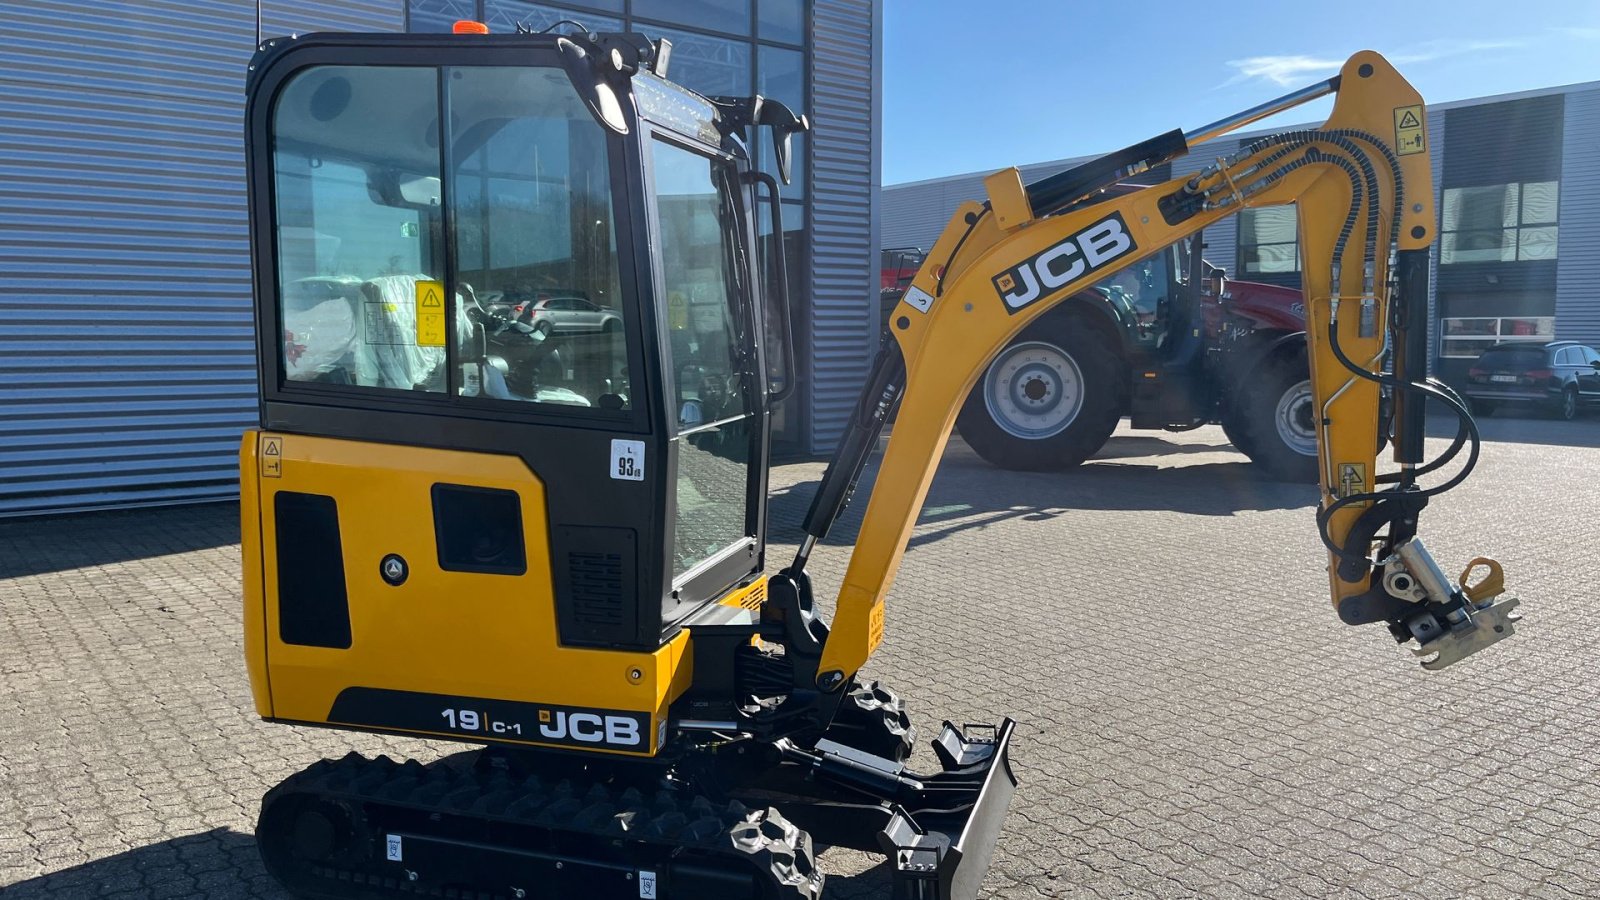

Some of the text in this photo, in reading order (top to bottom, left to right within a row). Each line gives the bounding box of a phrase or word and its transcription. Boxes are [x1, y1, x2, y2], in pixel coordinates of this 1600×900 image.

[1004, 218, 1131, 308] JCB
[618, 457, 634, 476] 93
[441, 708, 522, 735] 19 C-1
[539, 711, 641, 746] JCB
